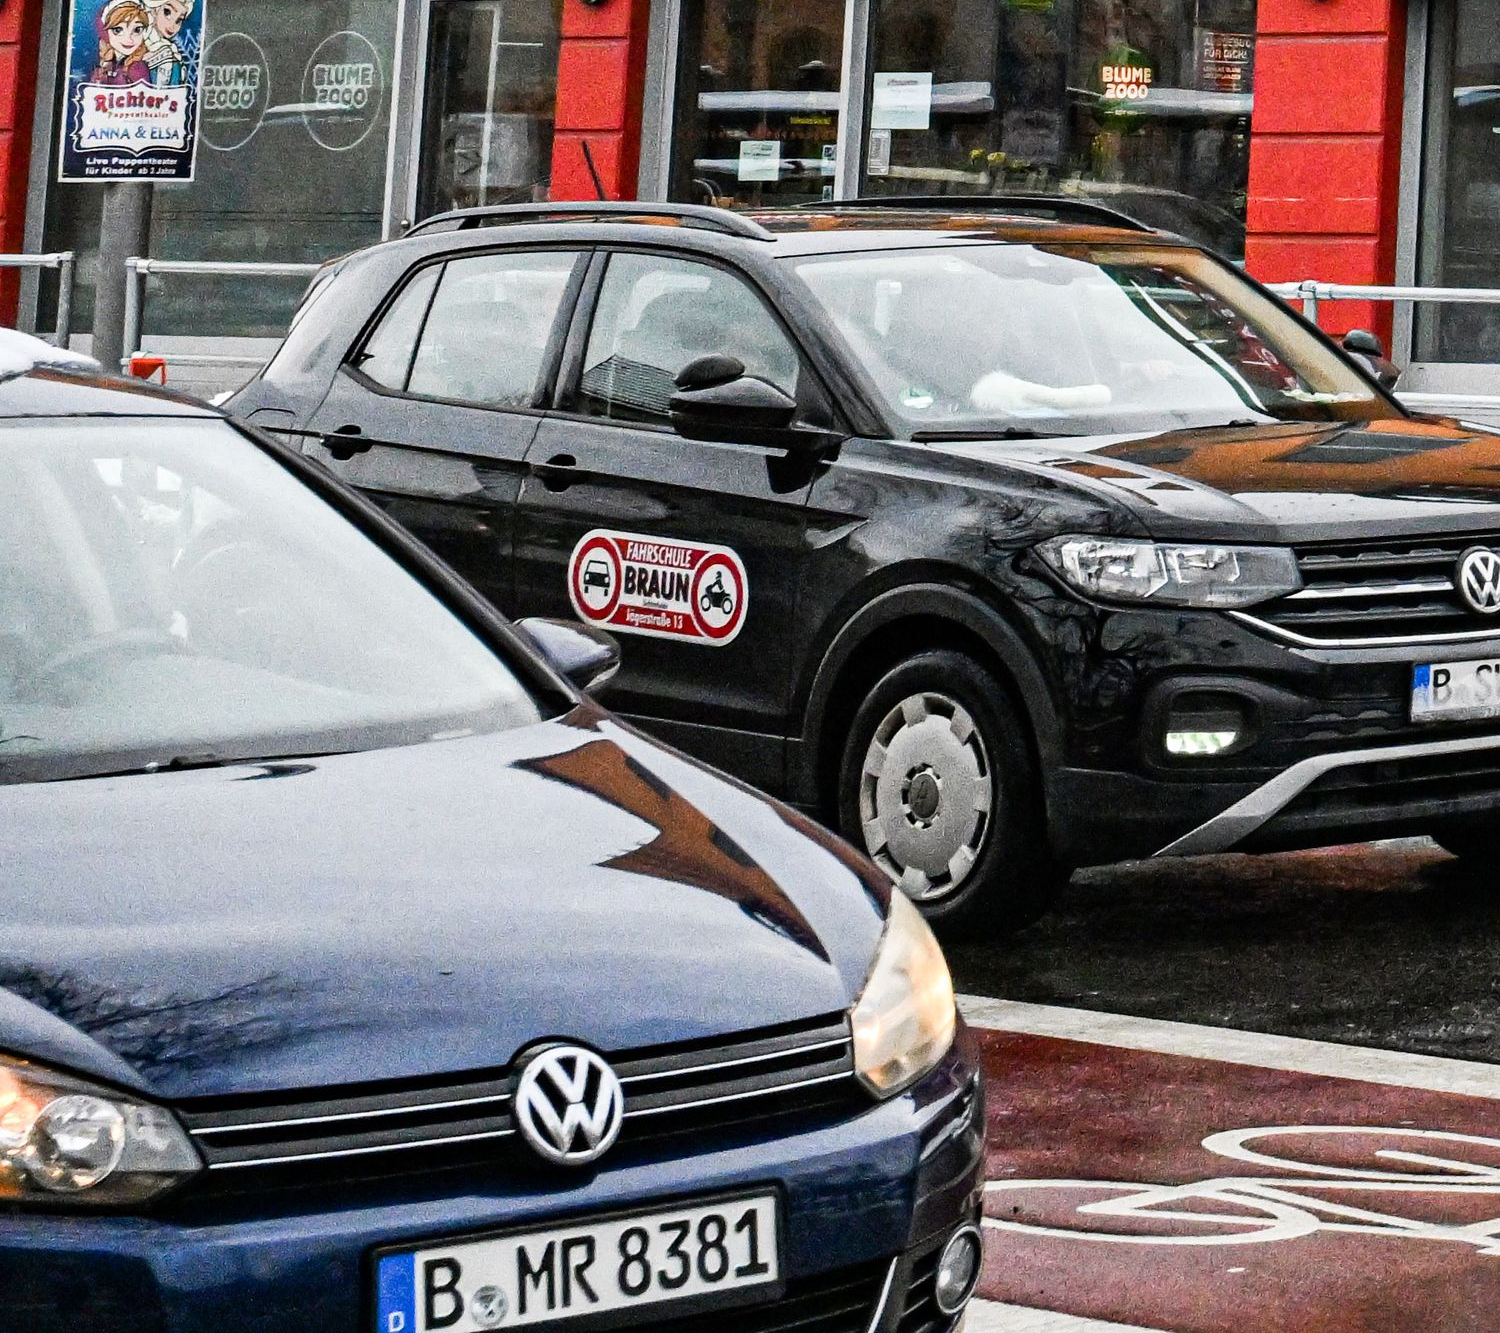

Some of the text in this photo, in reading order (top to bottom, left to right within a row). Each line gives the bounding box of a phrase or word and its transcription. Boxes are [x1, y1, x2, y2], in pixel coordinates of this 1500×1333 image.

[312, 64, 373, 87] BLUME
[1102, 66, 1152, 84] BLUME
[94, 91, 178, 113] Richter's
[1105, 84, 1149, 99] 2000
[87, 125, 179, 140] ANNA & ELSA
[85, 166, 99, 174] für
[101, 167, 133, 175] Kinder
[86, 156, 109, 165] Live
[626, 541, 692, 568] FAHRSCHULE
[624, 565, 690, 603] BRAUN
[625, 609, 683, 630] Jägerstraße 13
[1432, 668, 1453, 704] B
[422, 1207, 770, 1331] B MR 8381
[388, 1310, 405, 1332] D
